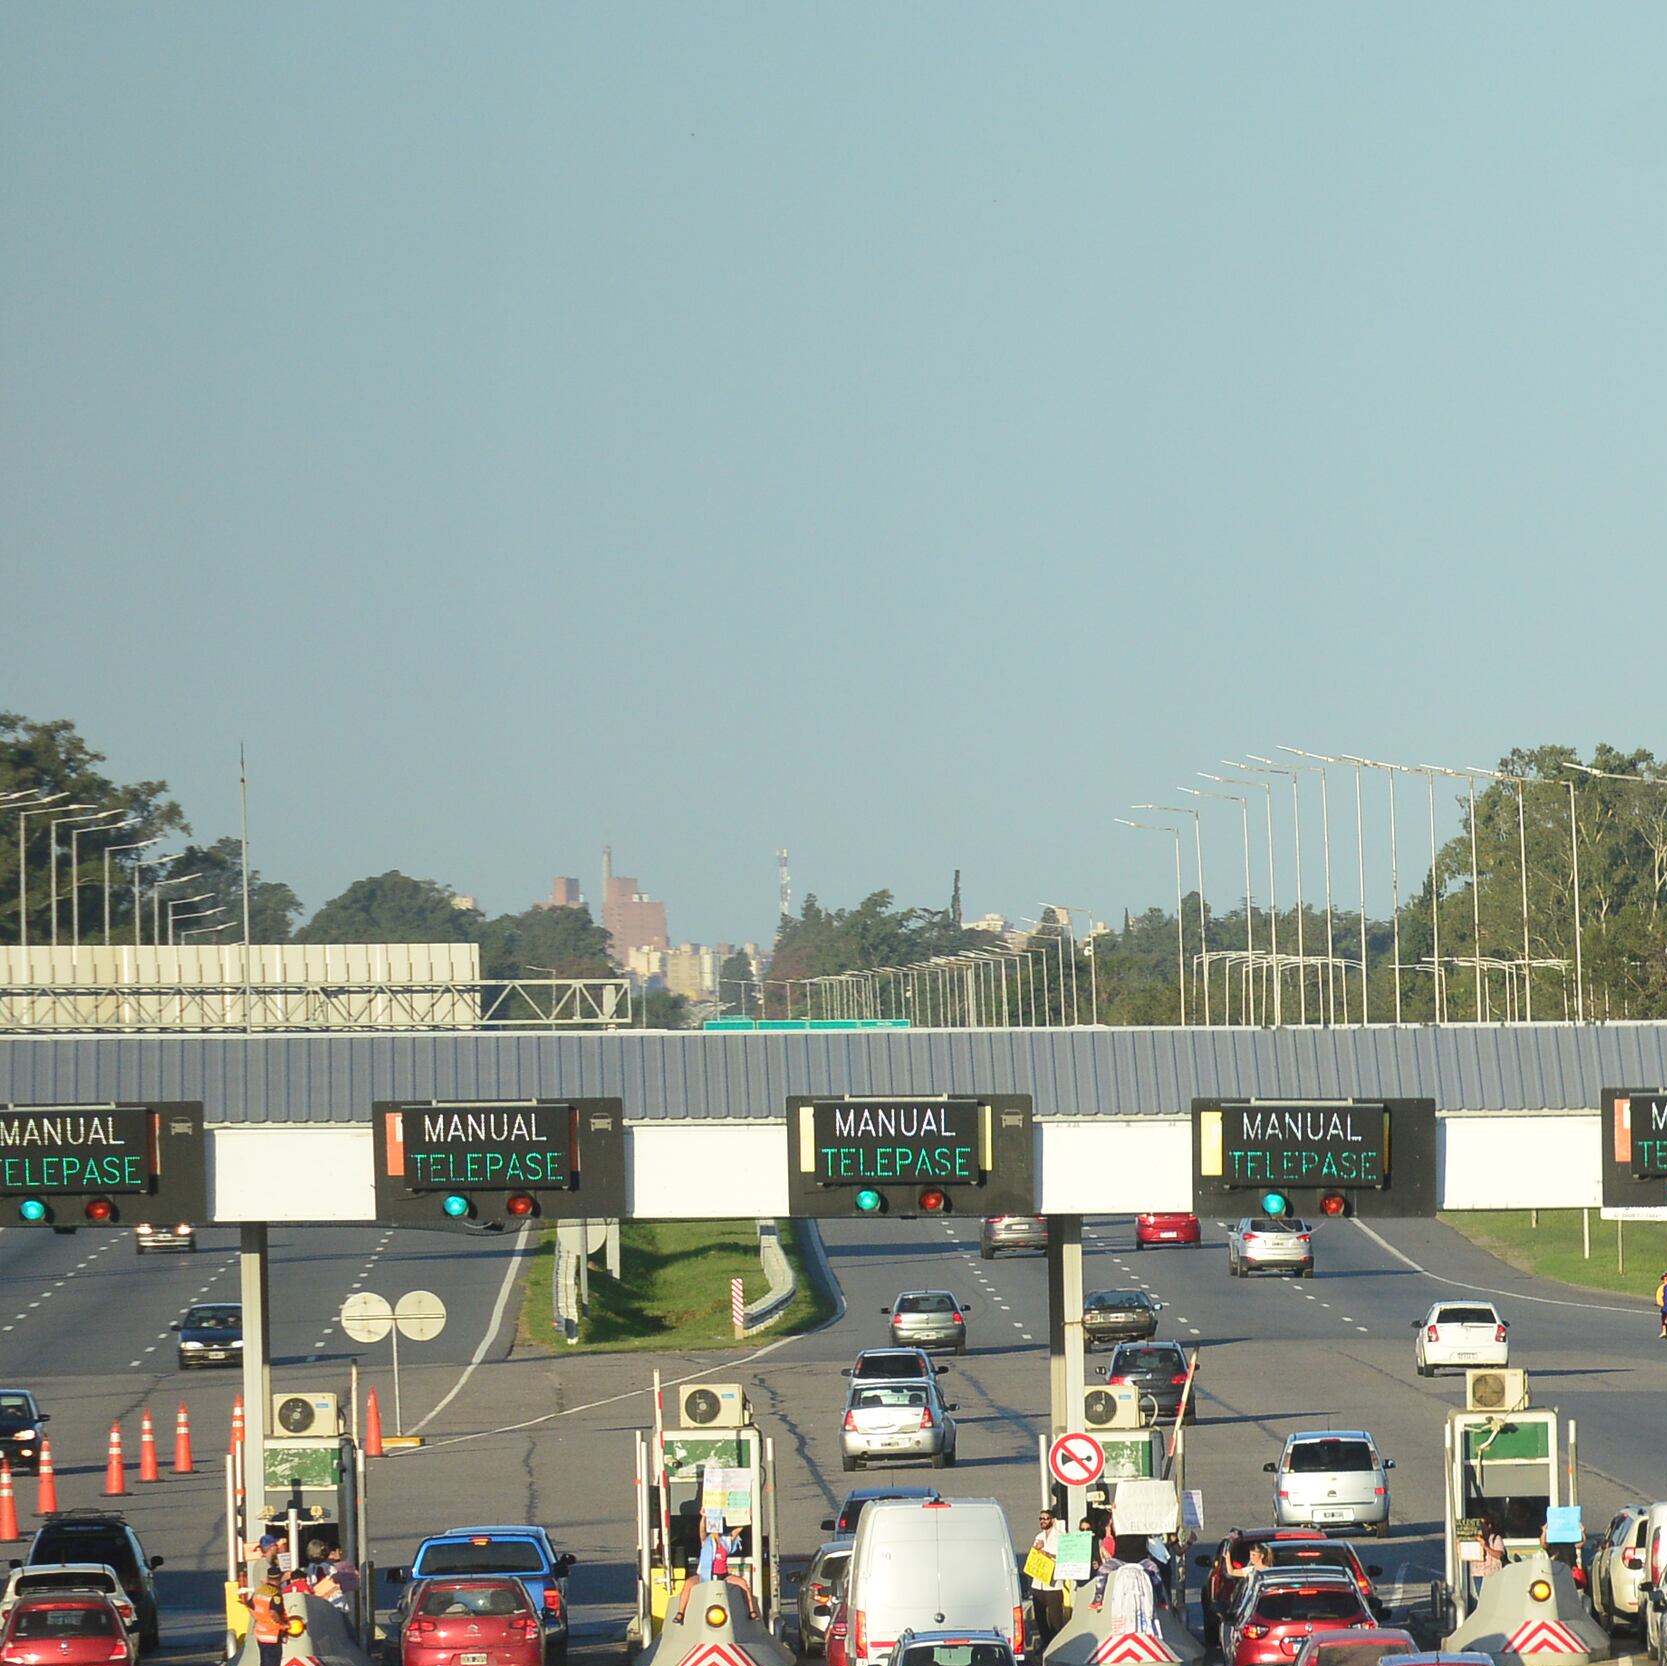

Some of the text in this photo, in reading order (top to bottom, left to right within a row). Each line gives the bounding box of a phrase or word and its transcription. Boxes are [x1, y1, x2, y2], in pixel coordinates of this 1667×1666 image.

[0, 1117, 125, 1146] MANUAL
[423, 1112, 548, 1144] MANUAL
[834, 1107, 956, 1138] MANUAL
[1242, 1112, 1363, 1143] MANUAL
[411, 1151, 567, 1183] TELEPASE
[821, 1146, 972, 1178] TELEPASE
[1229, 1150, 1378, 1182] TELEPASE
